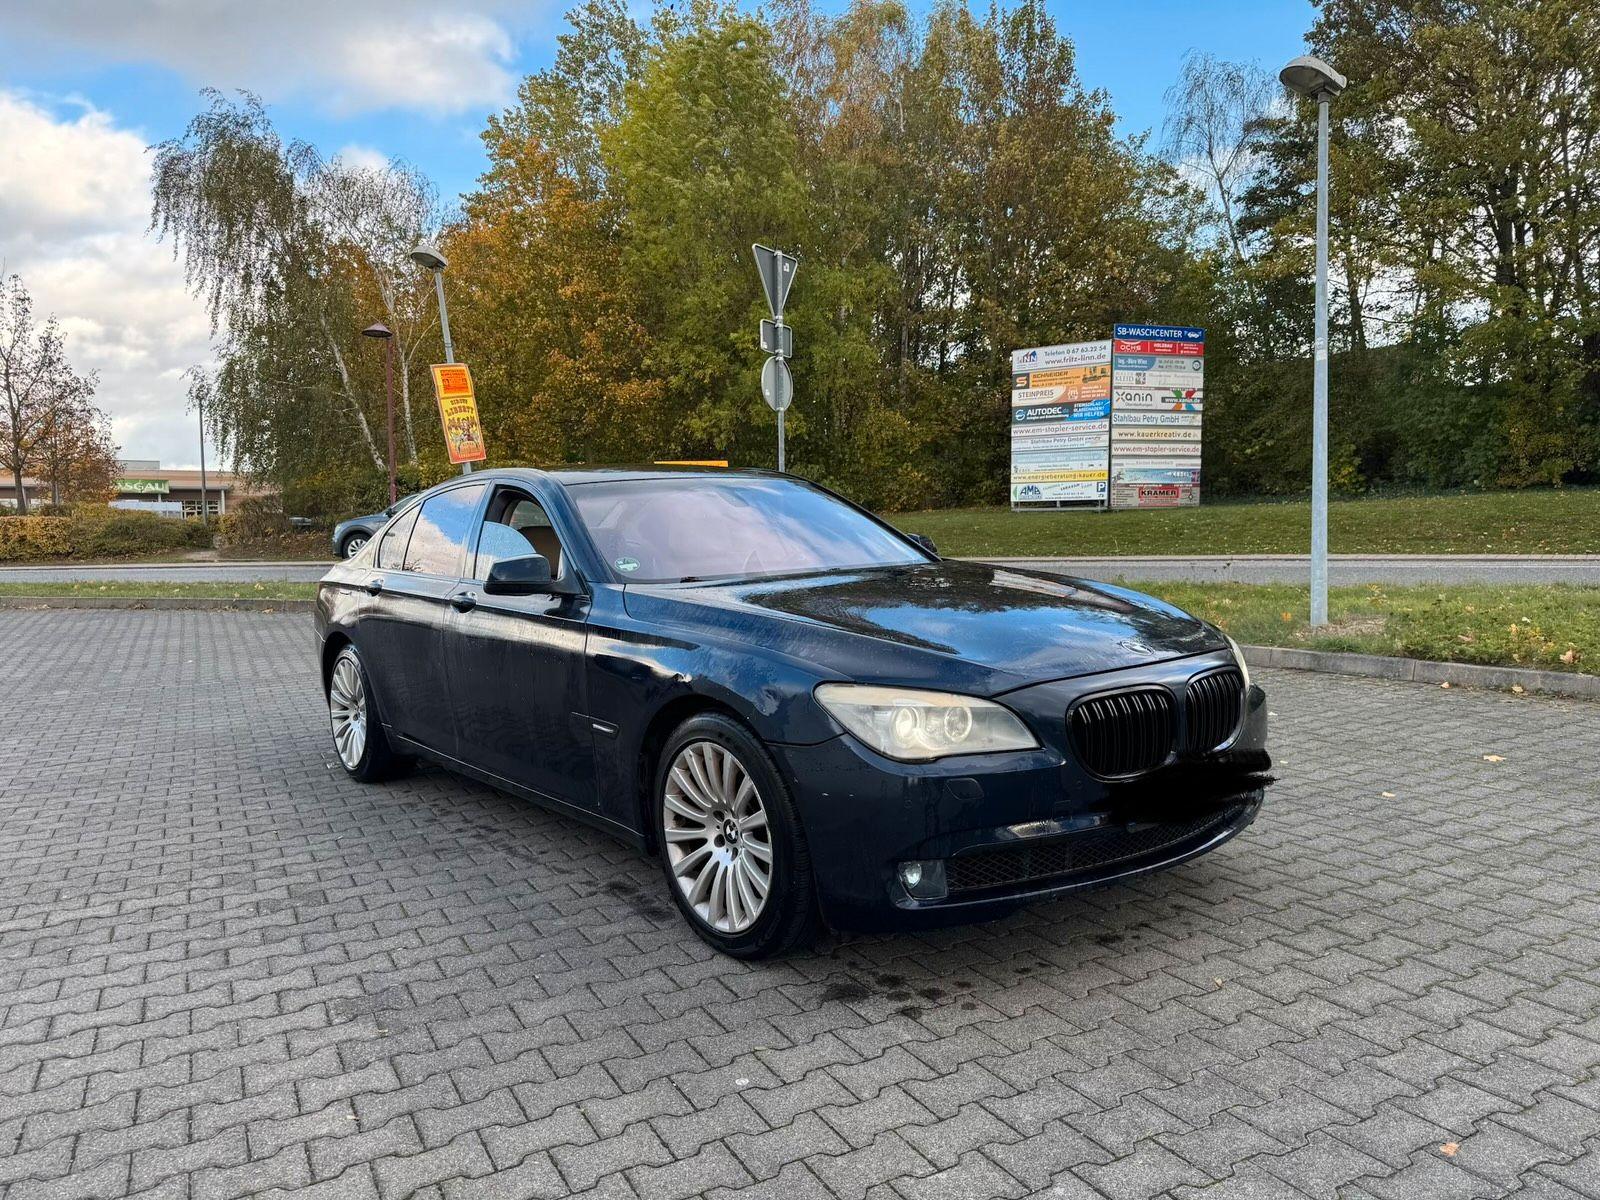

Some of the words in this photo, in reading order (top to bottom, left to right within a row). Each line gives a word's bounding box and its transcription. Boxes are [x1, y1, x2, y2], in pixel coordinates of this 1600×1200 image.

[1117, 327, 1183, 338] SB-WASCHCENTER
[1045, 353, 1106, 365] www.fritz-linn.de
[1032, 371, 1068, 379] SCHNEIDER
[1018, 389, 1054, 399] STEINPREIS
[1113, 414, 1140, 423] Stahlbau
[1142, 414, 1159, 425] Petry
[1160, 414, 1180, 423] GmbH
[1012, 423, 1107, 435] www.em-stapler-service.de
[1117, 430, 1192, 438] www.kauerkreativ.de
[1113, 445, 1200, 454] www.em-stapler-service.de
